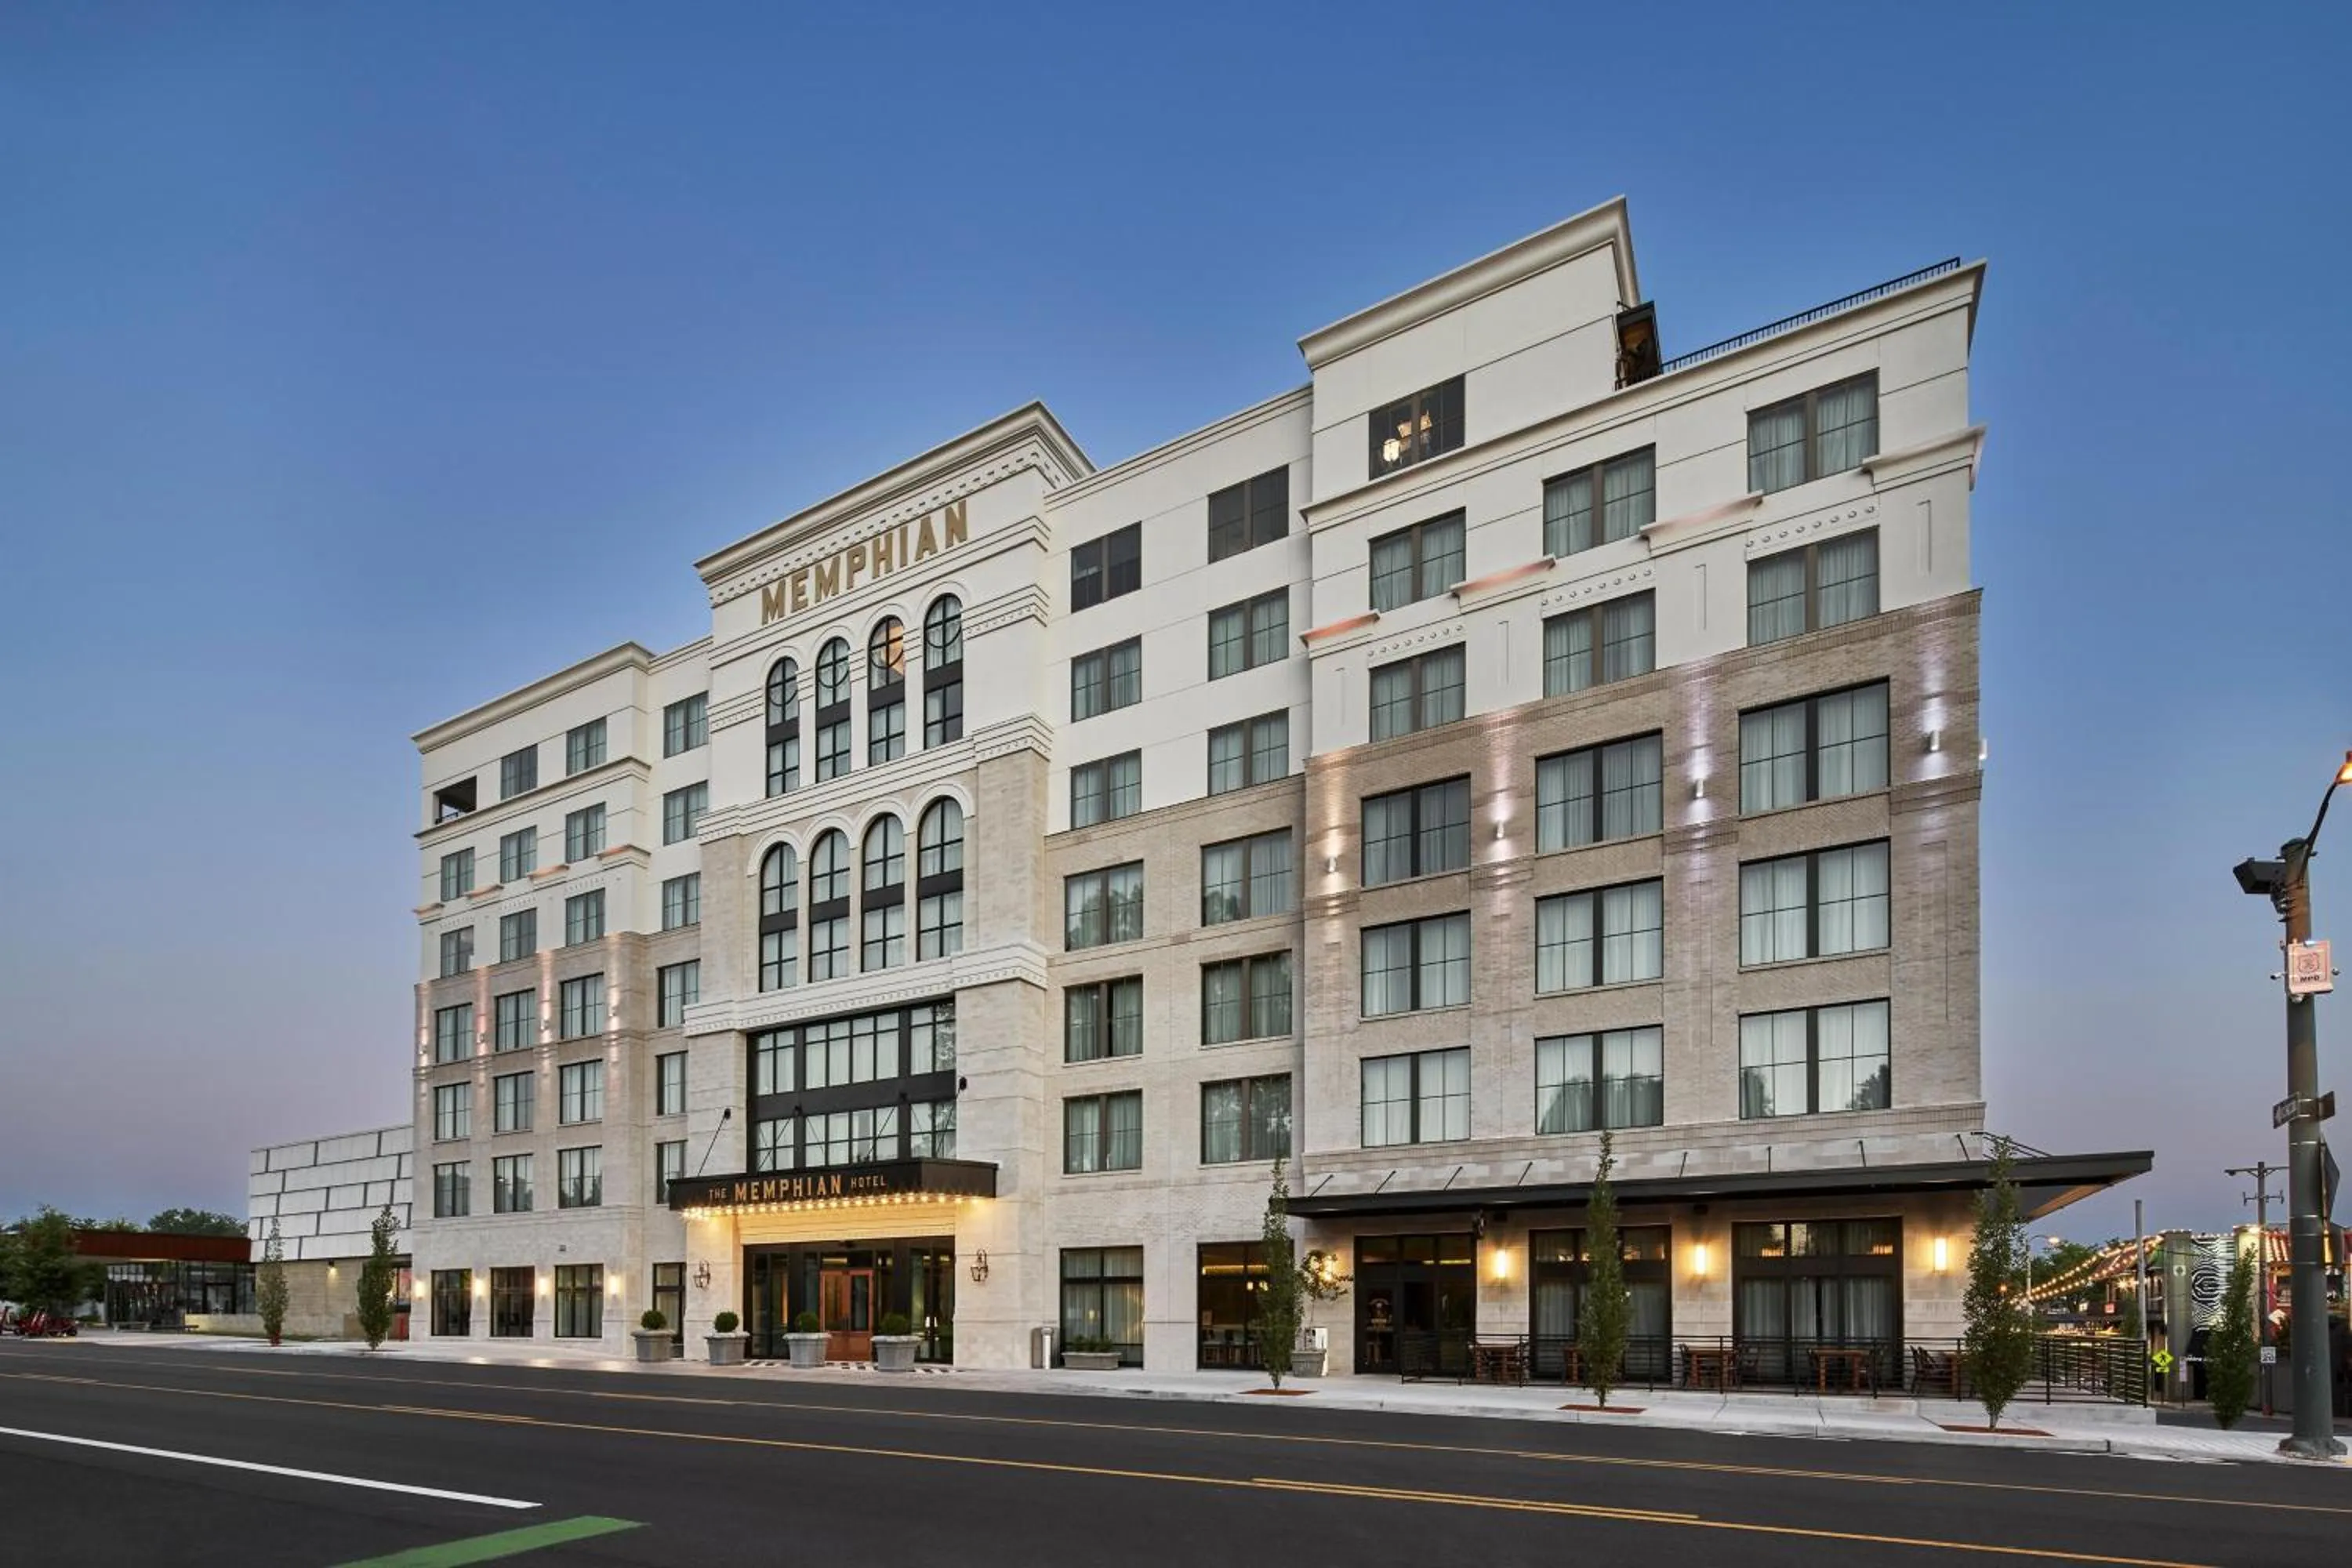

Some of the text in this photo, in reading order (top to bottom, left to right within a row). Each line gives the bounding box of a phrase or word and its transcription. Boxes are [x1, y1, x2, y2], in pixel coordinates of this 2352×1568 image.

[761, 499, 968, 626] MEMPHIAN
[709, 1174, 887, 1202] THE MEMPHIAN HOTEL
